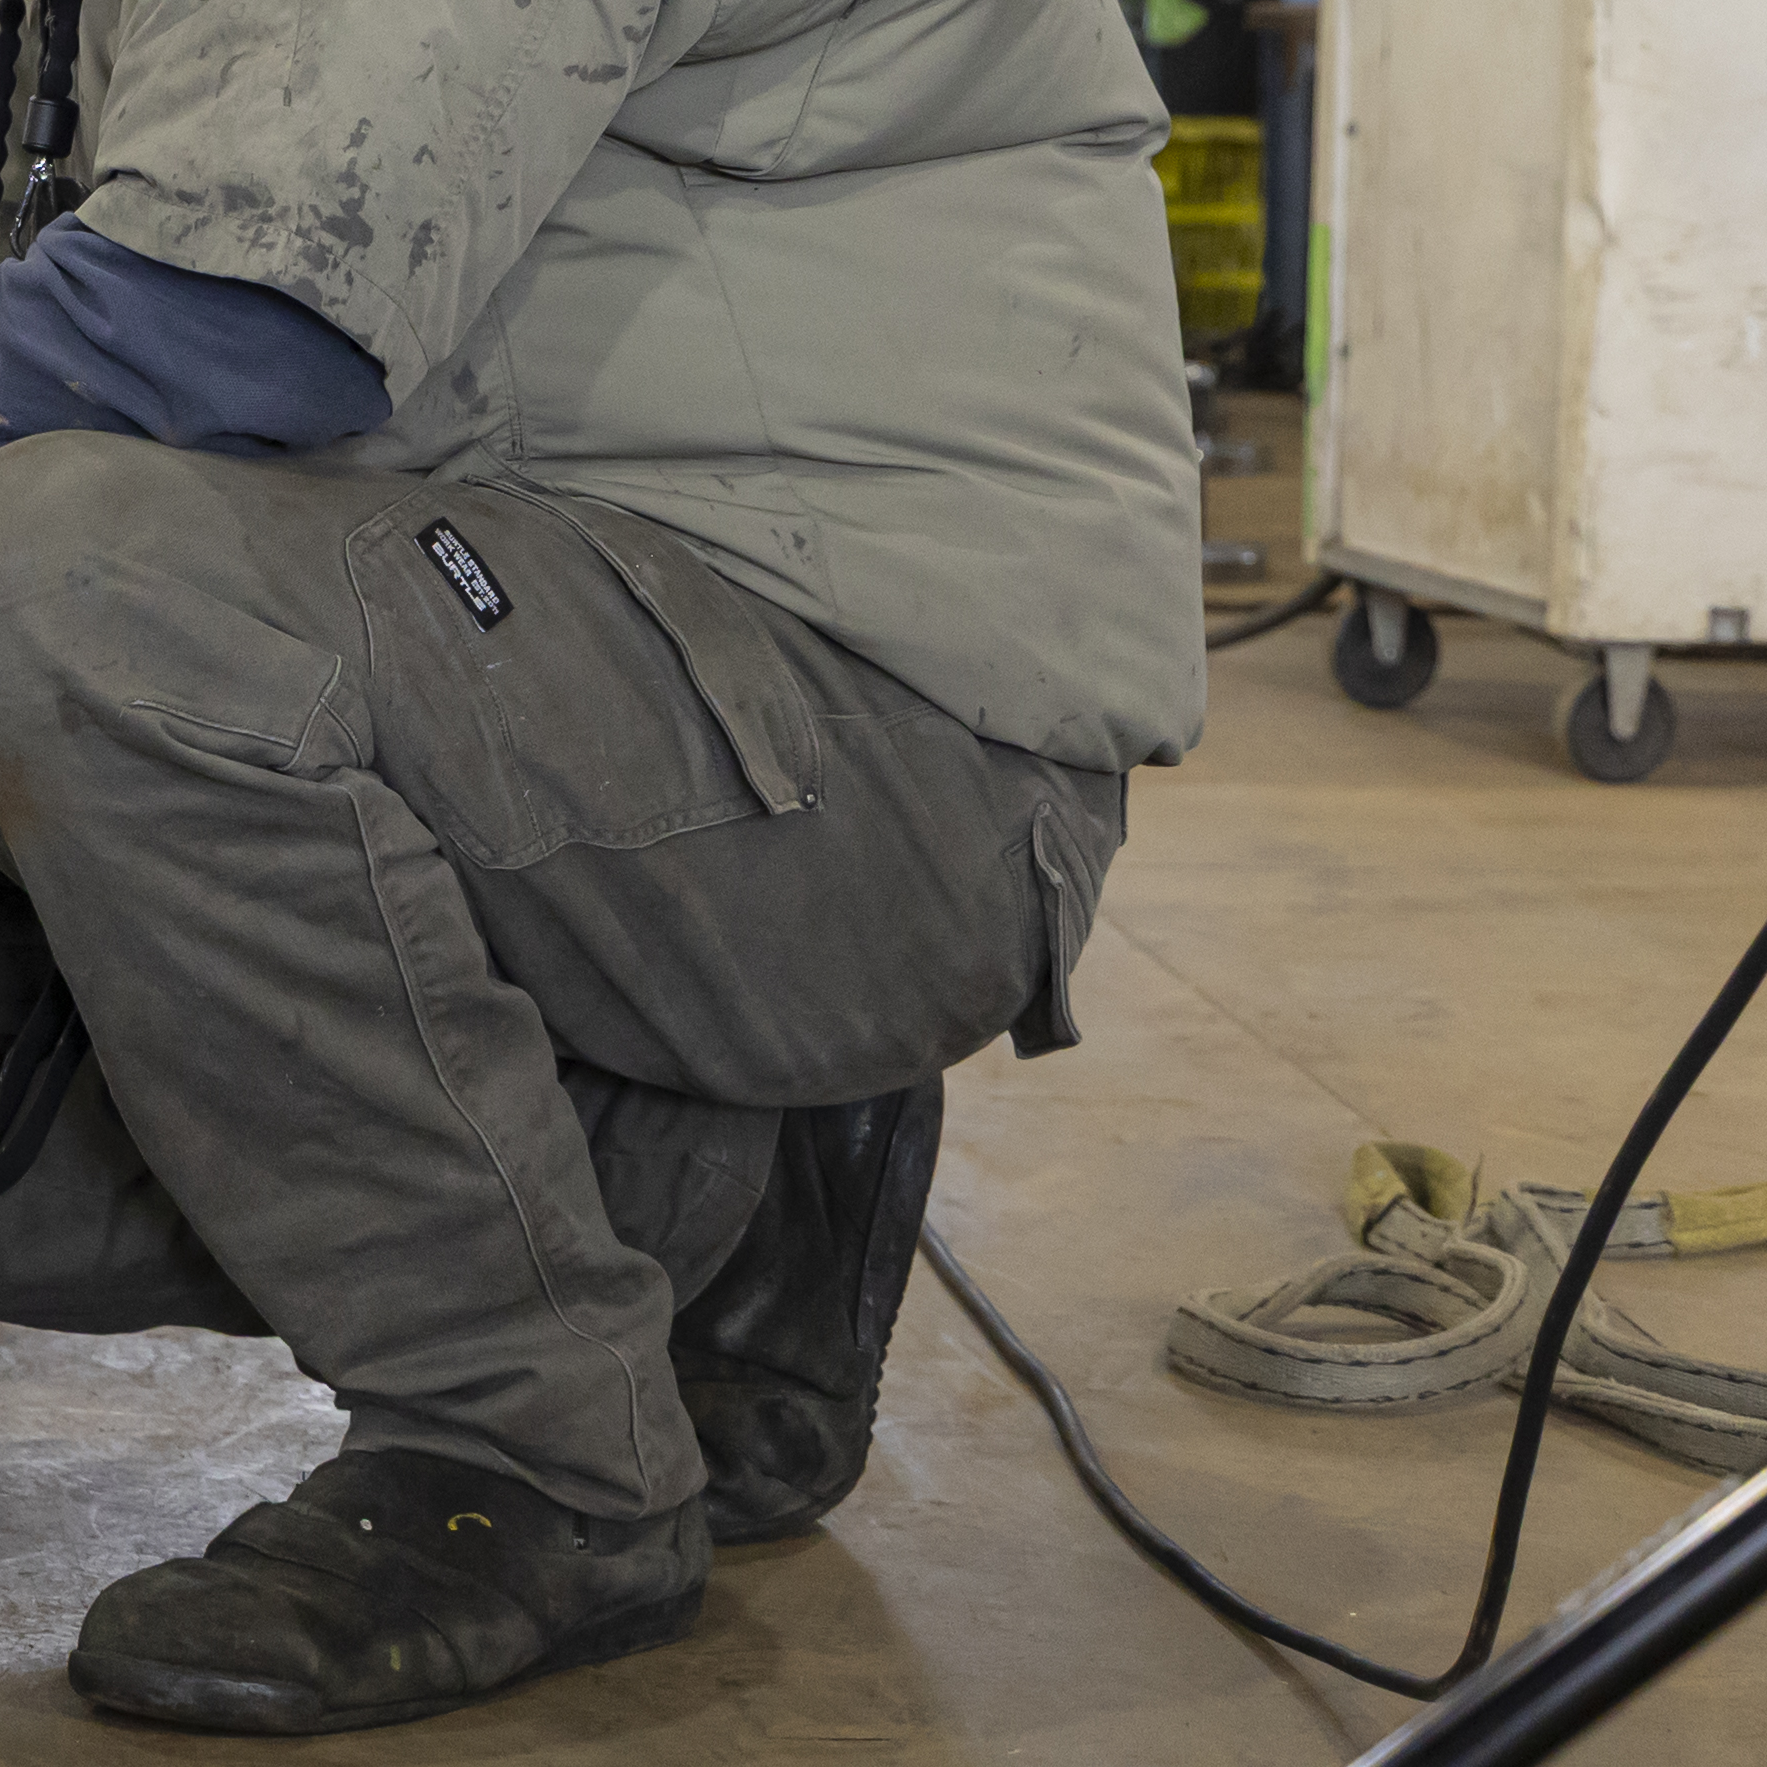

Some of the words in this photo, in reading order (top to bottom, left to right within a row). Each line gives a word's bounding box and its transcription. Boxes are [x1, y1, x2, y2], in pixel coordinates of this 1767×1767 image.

[431, 541, 487, 612] BURTLE
[435, 528, 455, 553] WORK
[453, 550, 473, 577] WEAR
[444, 529, 471, 560] BURTLE
[467, 559, 500, 605] STANDARD
